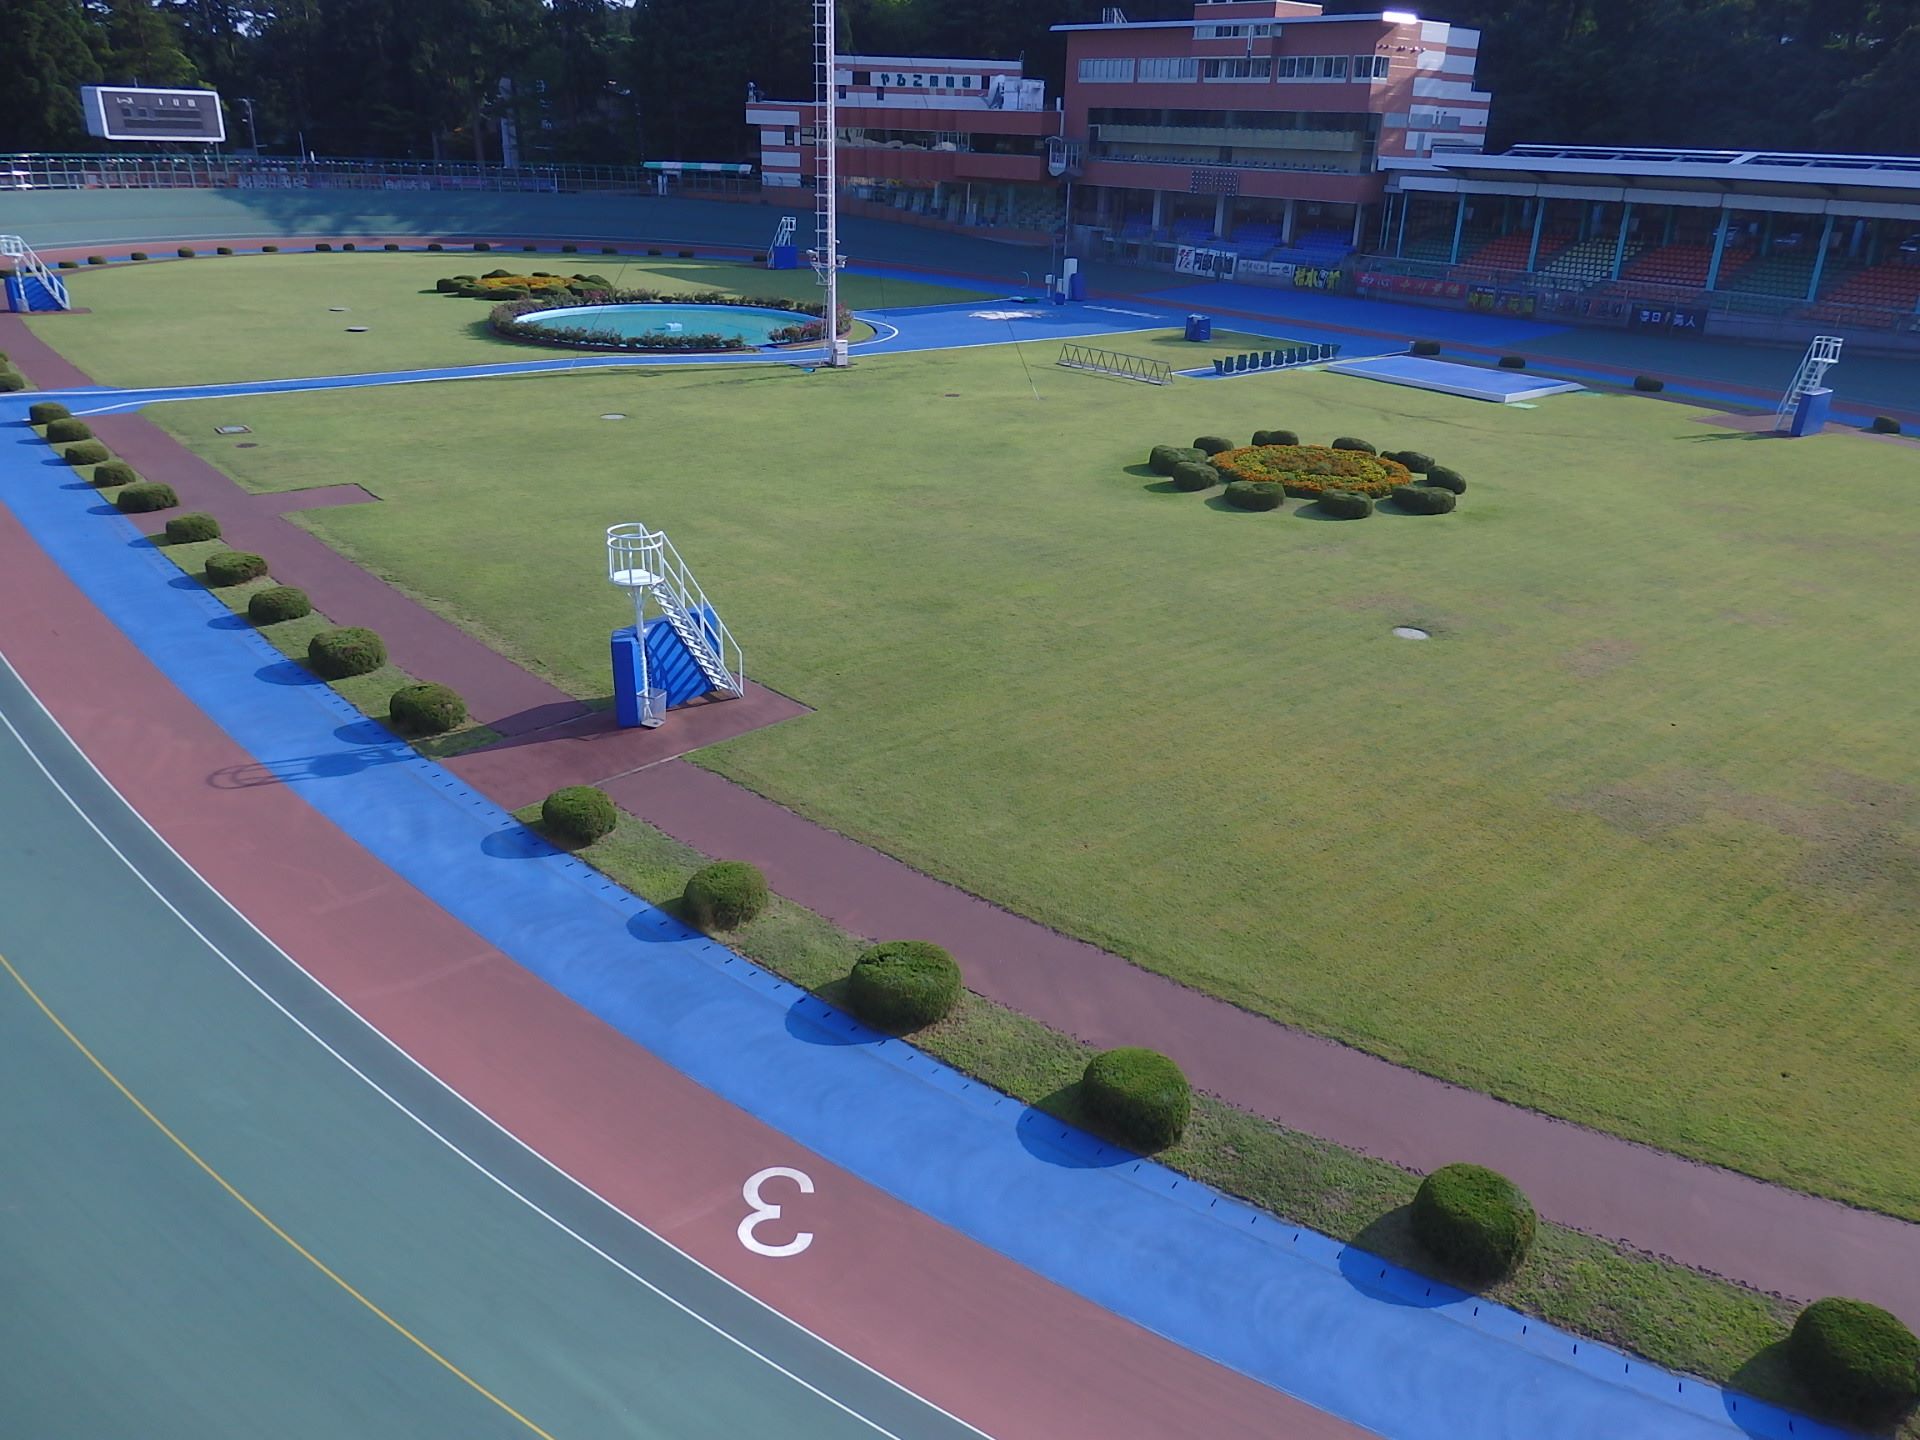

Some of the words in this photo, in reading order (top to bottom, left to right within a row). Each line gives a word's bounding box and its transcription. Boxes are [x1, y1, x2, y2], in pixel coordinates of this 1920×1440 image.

[881, 73, 971, 89] やひこ
[737, 1166, 815, 1258] 3
